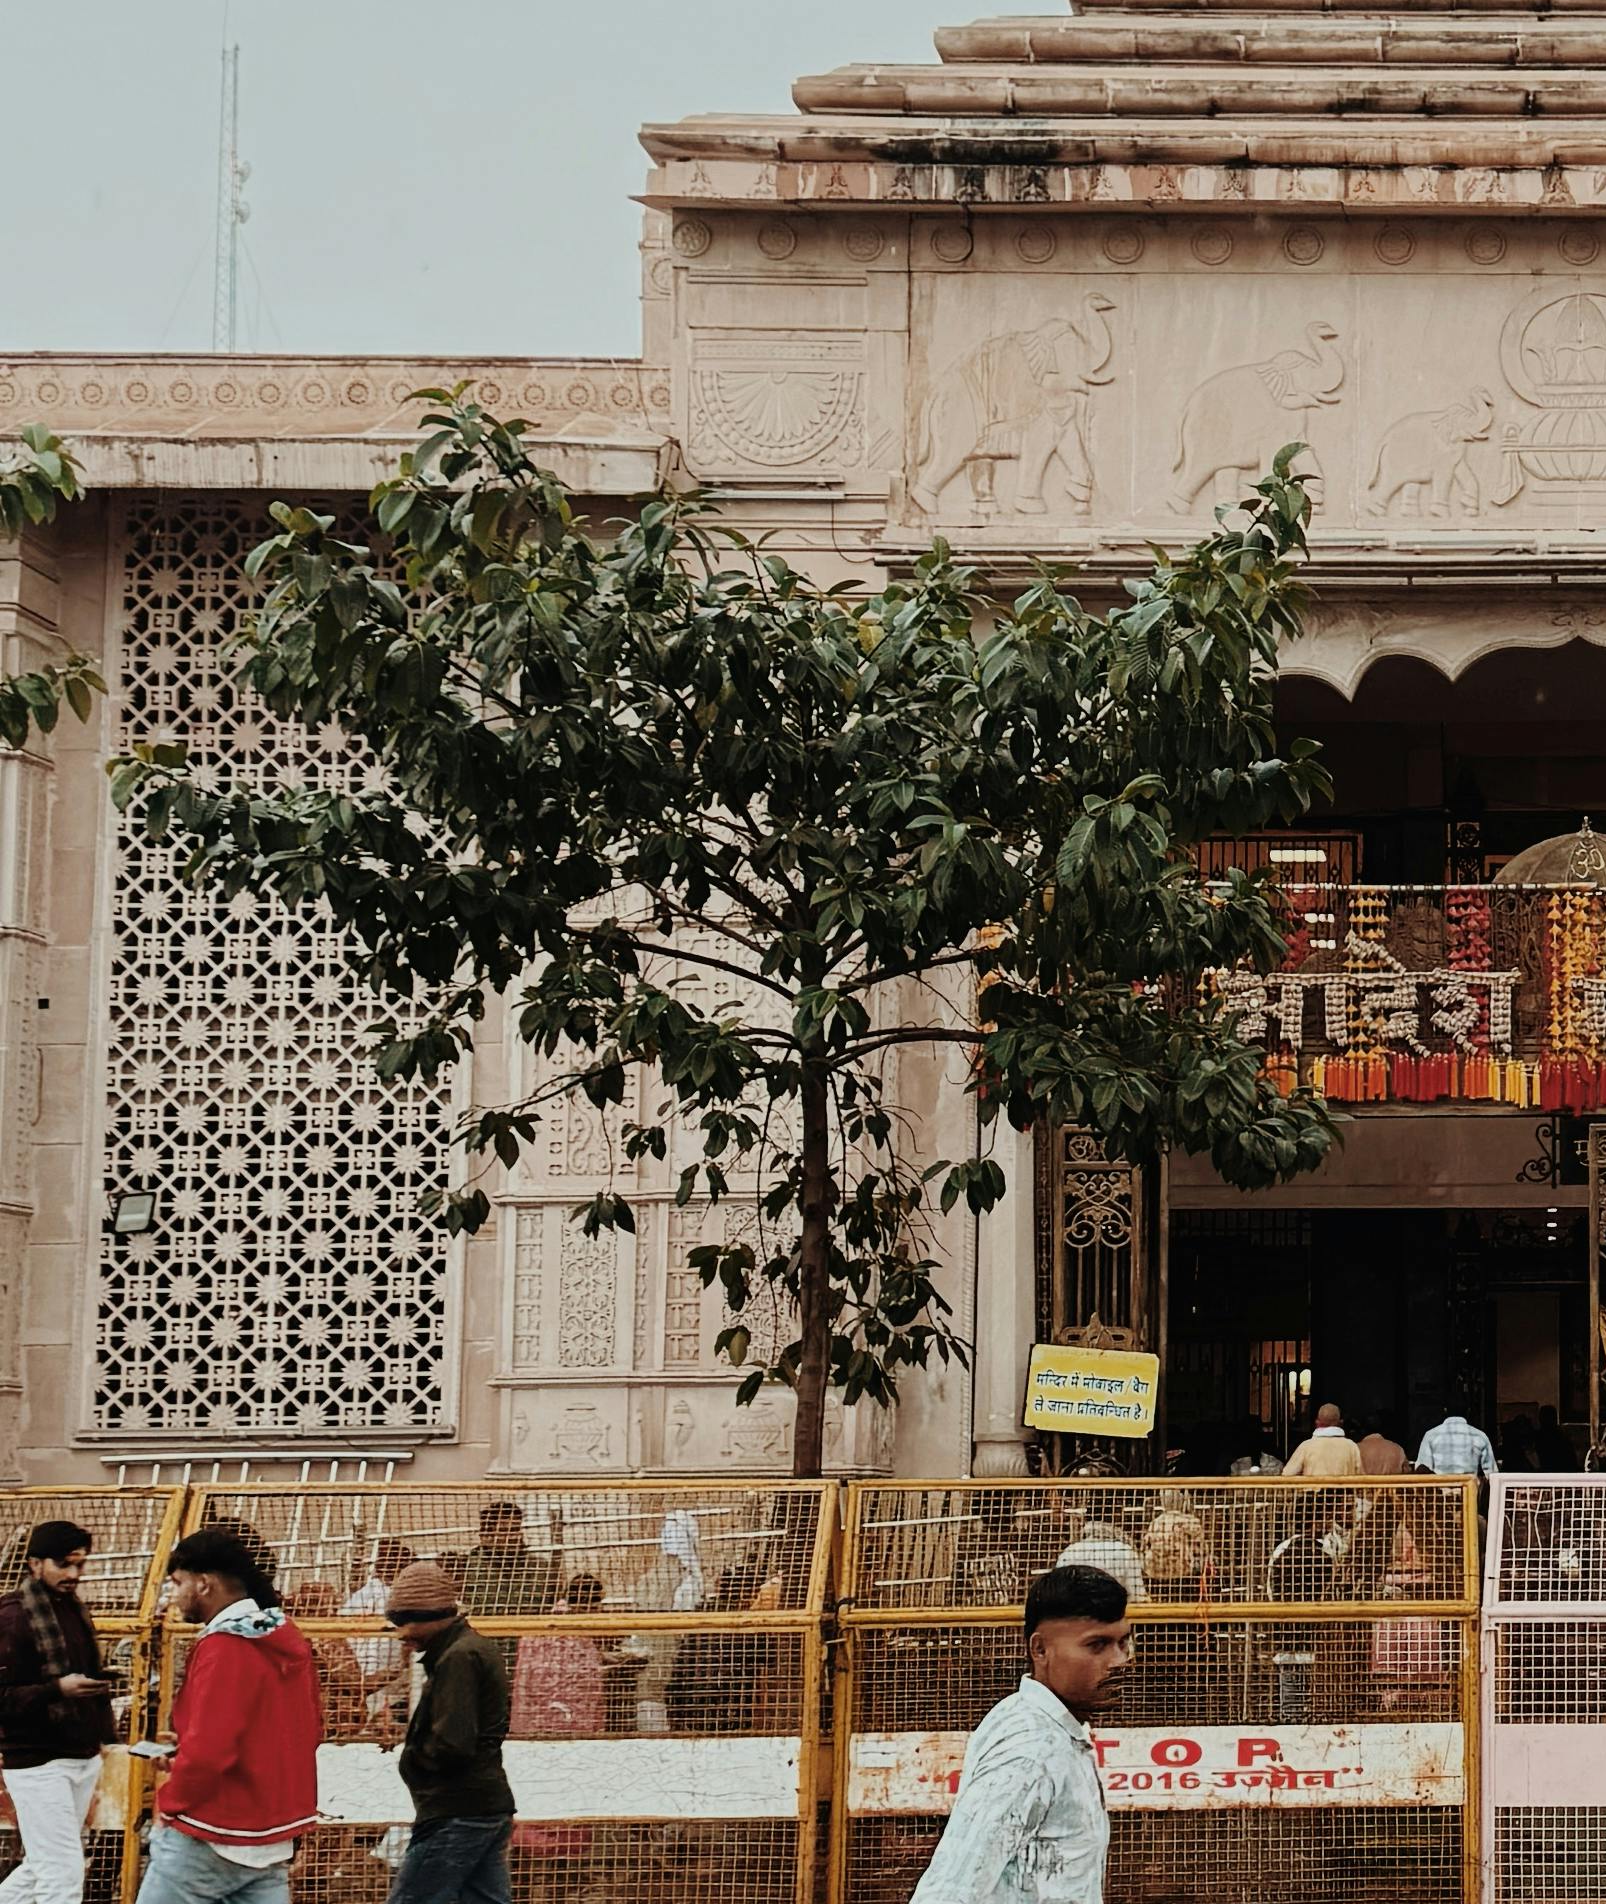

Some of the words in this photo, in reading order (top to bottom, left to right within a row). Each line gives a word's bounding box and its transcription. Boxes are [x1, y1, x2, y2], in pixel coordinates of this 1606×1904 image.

[1070, 1372, 1079, 1389] में
[1094, 1738, 1280, 1767] TOP
[1107, 1771, 1201, 1790] 2016
